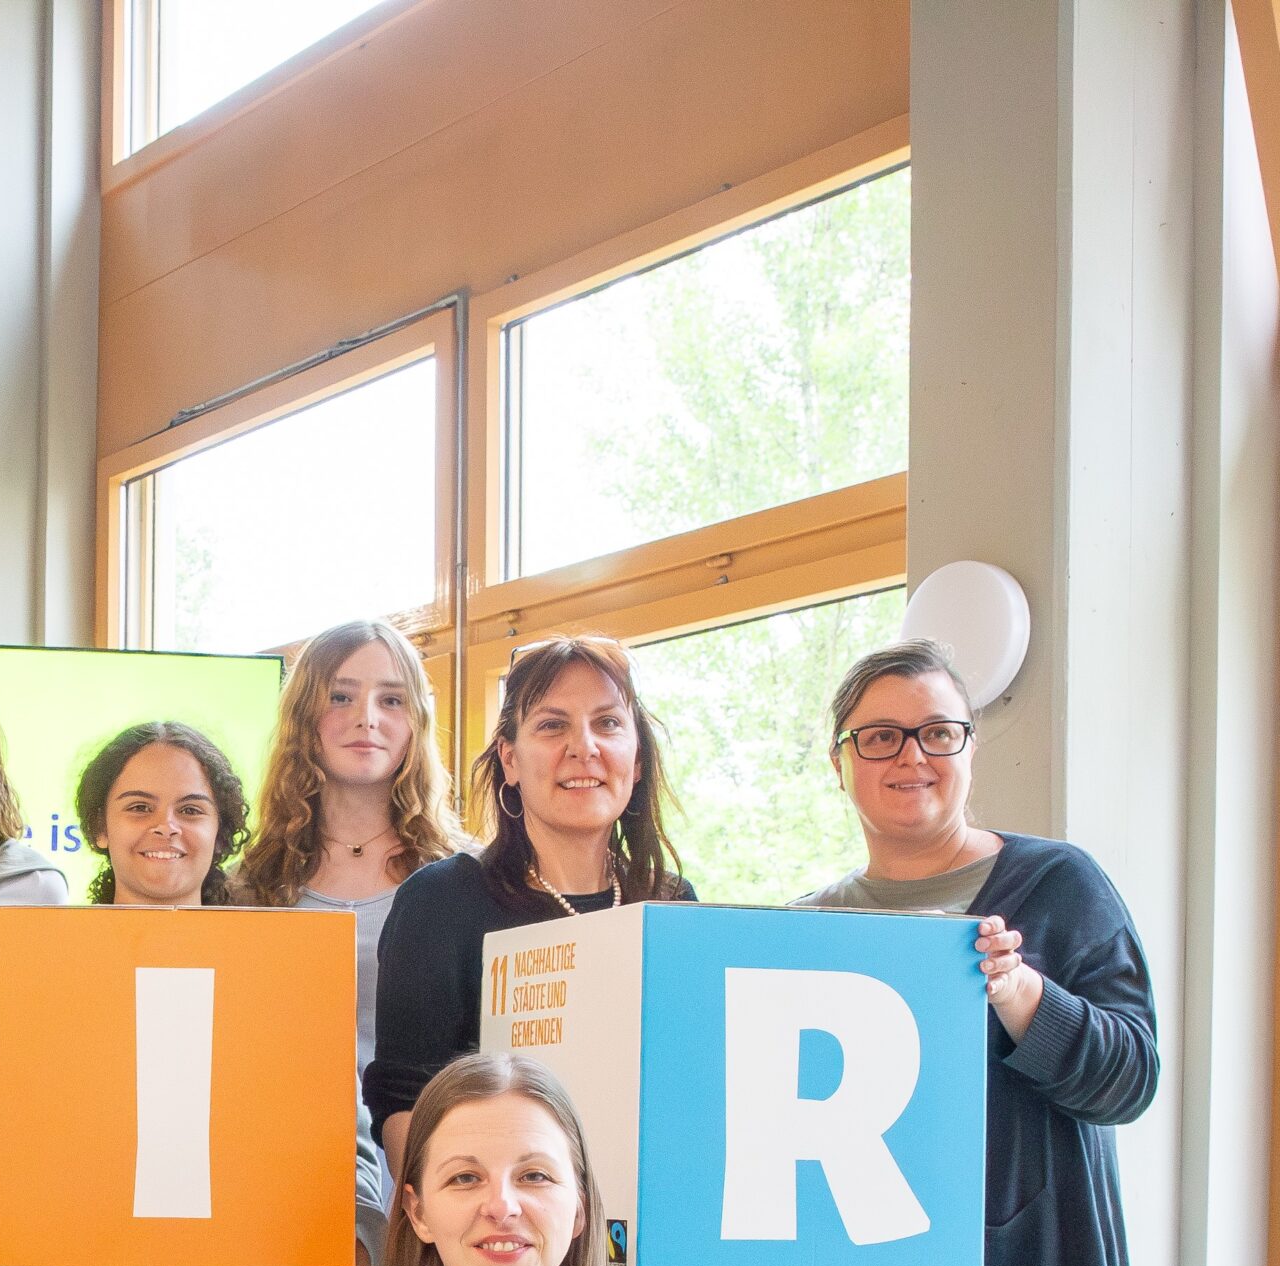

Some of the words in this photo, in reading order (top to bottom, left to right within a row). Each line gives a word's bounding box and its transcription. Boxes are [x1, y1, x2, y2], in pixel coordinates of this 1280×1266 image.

[490, 954, 508, 1016] 11
[514, 942, 576, 978] NACHHALTIGE
[512, 981, 547, 1013] STÄDTE
[547, 980, 567, 1009] UND
[511, 1017, 563, 1048] GEMEINDEN
